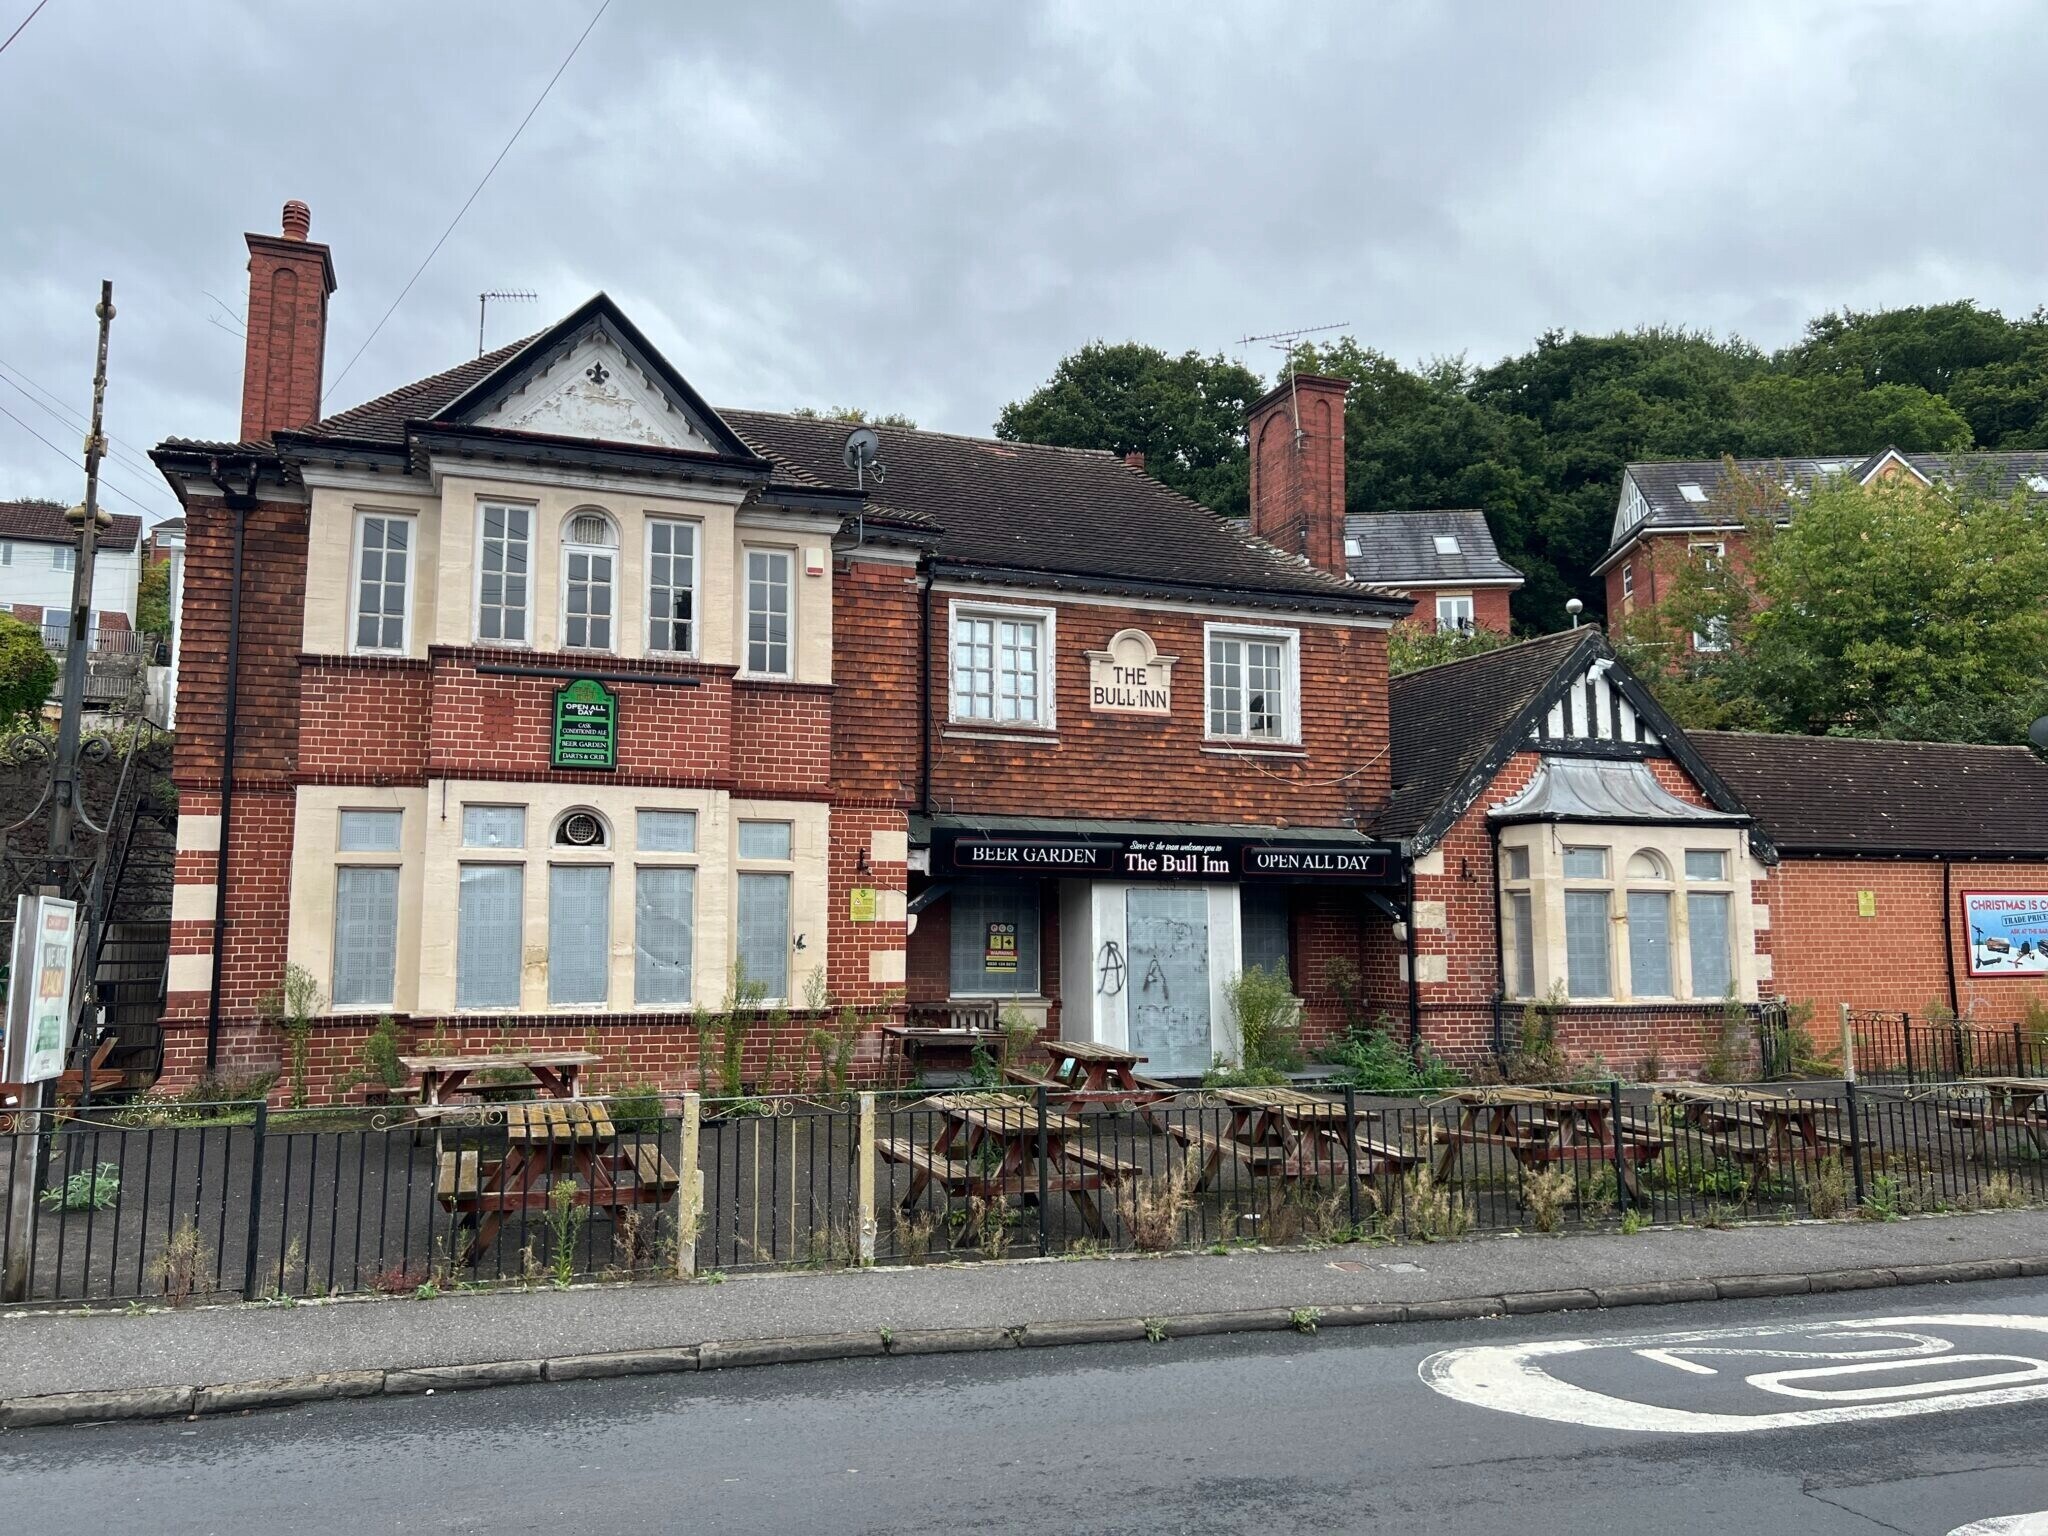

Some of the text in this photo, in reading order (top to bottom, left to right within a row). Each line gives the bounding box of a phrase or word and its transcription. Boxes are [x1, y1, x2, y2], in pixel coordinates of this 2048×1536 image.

[1113, 666, 1147, 685] THE
[972, 847, 1097, 863] BEER GARDEN
[1155, 841, 1166, 851] the
[1179, 842, 1205, 852] welcome
[1203, 846, 1216, 854] you
[1124, 853, 1230, 873] The Bull Inn
[1257, 854, 1371, 870] OPEN ALL DAY
[1970, 900, 2026, 911] CHRISTMAS
[2028, 900, 2038, 910] IS
[2004, 916, 2027, 924] TRADE
